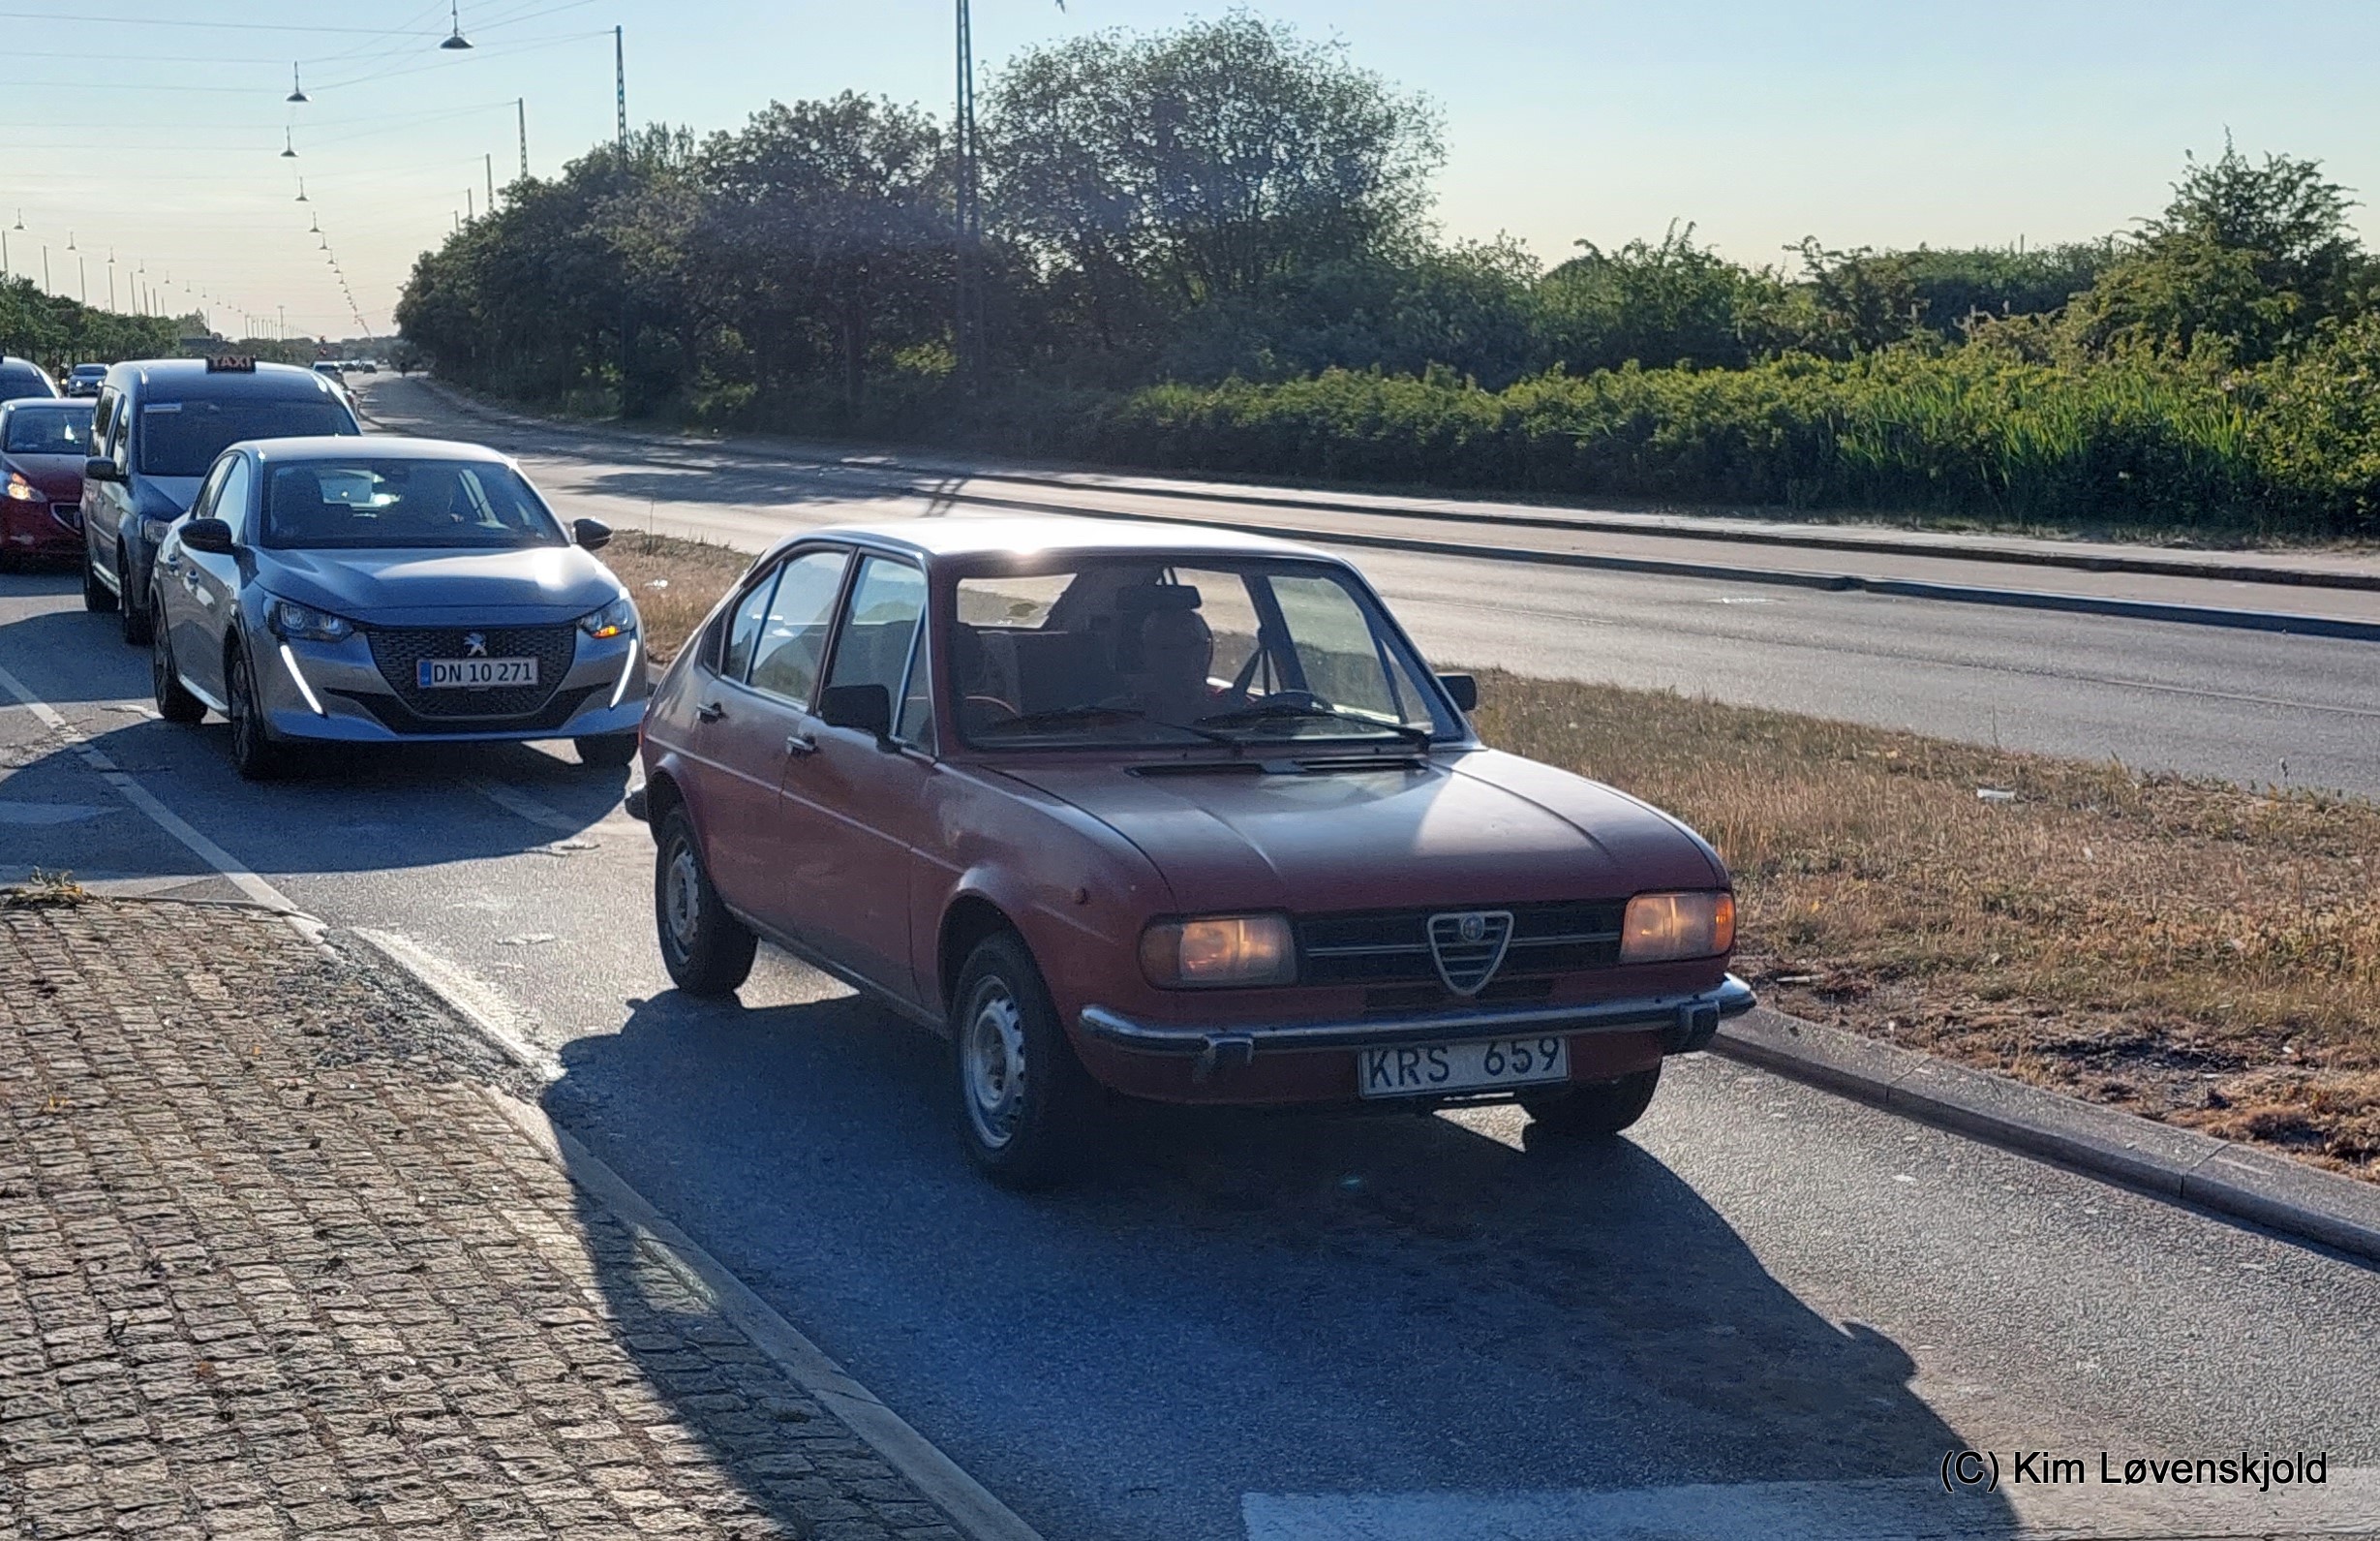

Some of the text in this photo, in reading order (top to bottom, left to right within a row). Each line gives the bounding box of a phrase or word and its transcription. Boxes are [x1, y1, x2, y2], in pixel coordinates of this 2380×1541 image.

[213, 355, 251, 367] TAXI
[434, 663, 532, 683] DN 10 271
[1368, 1036, 1559, 1088] KRS 659
